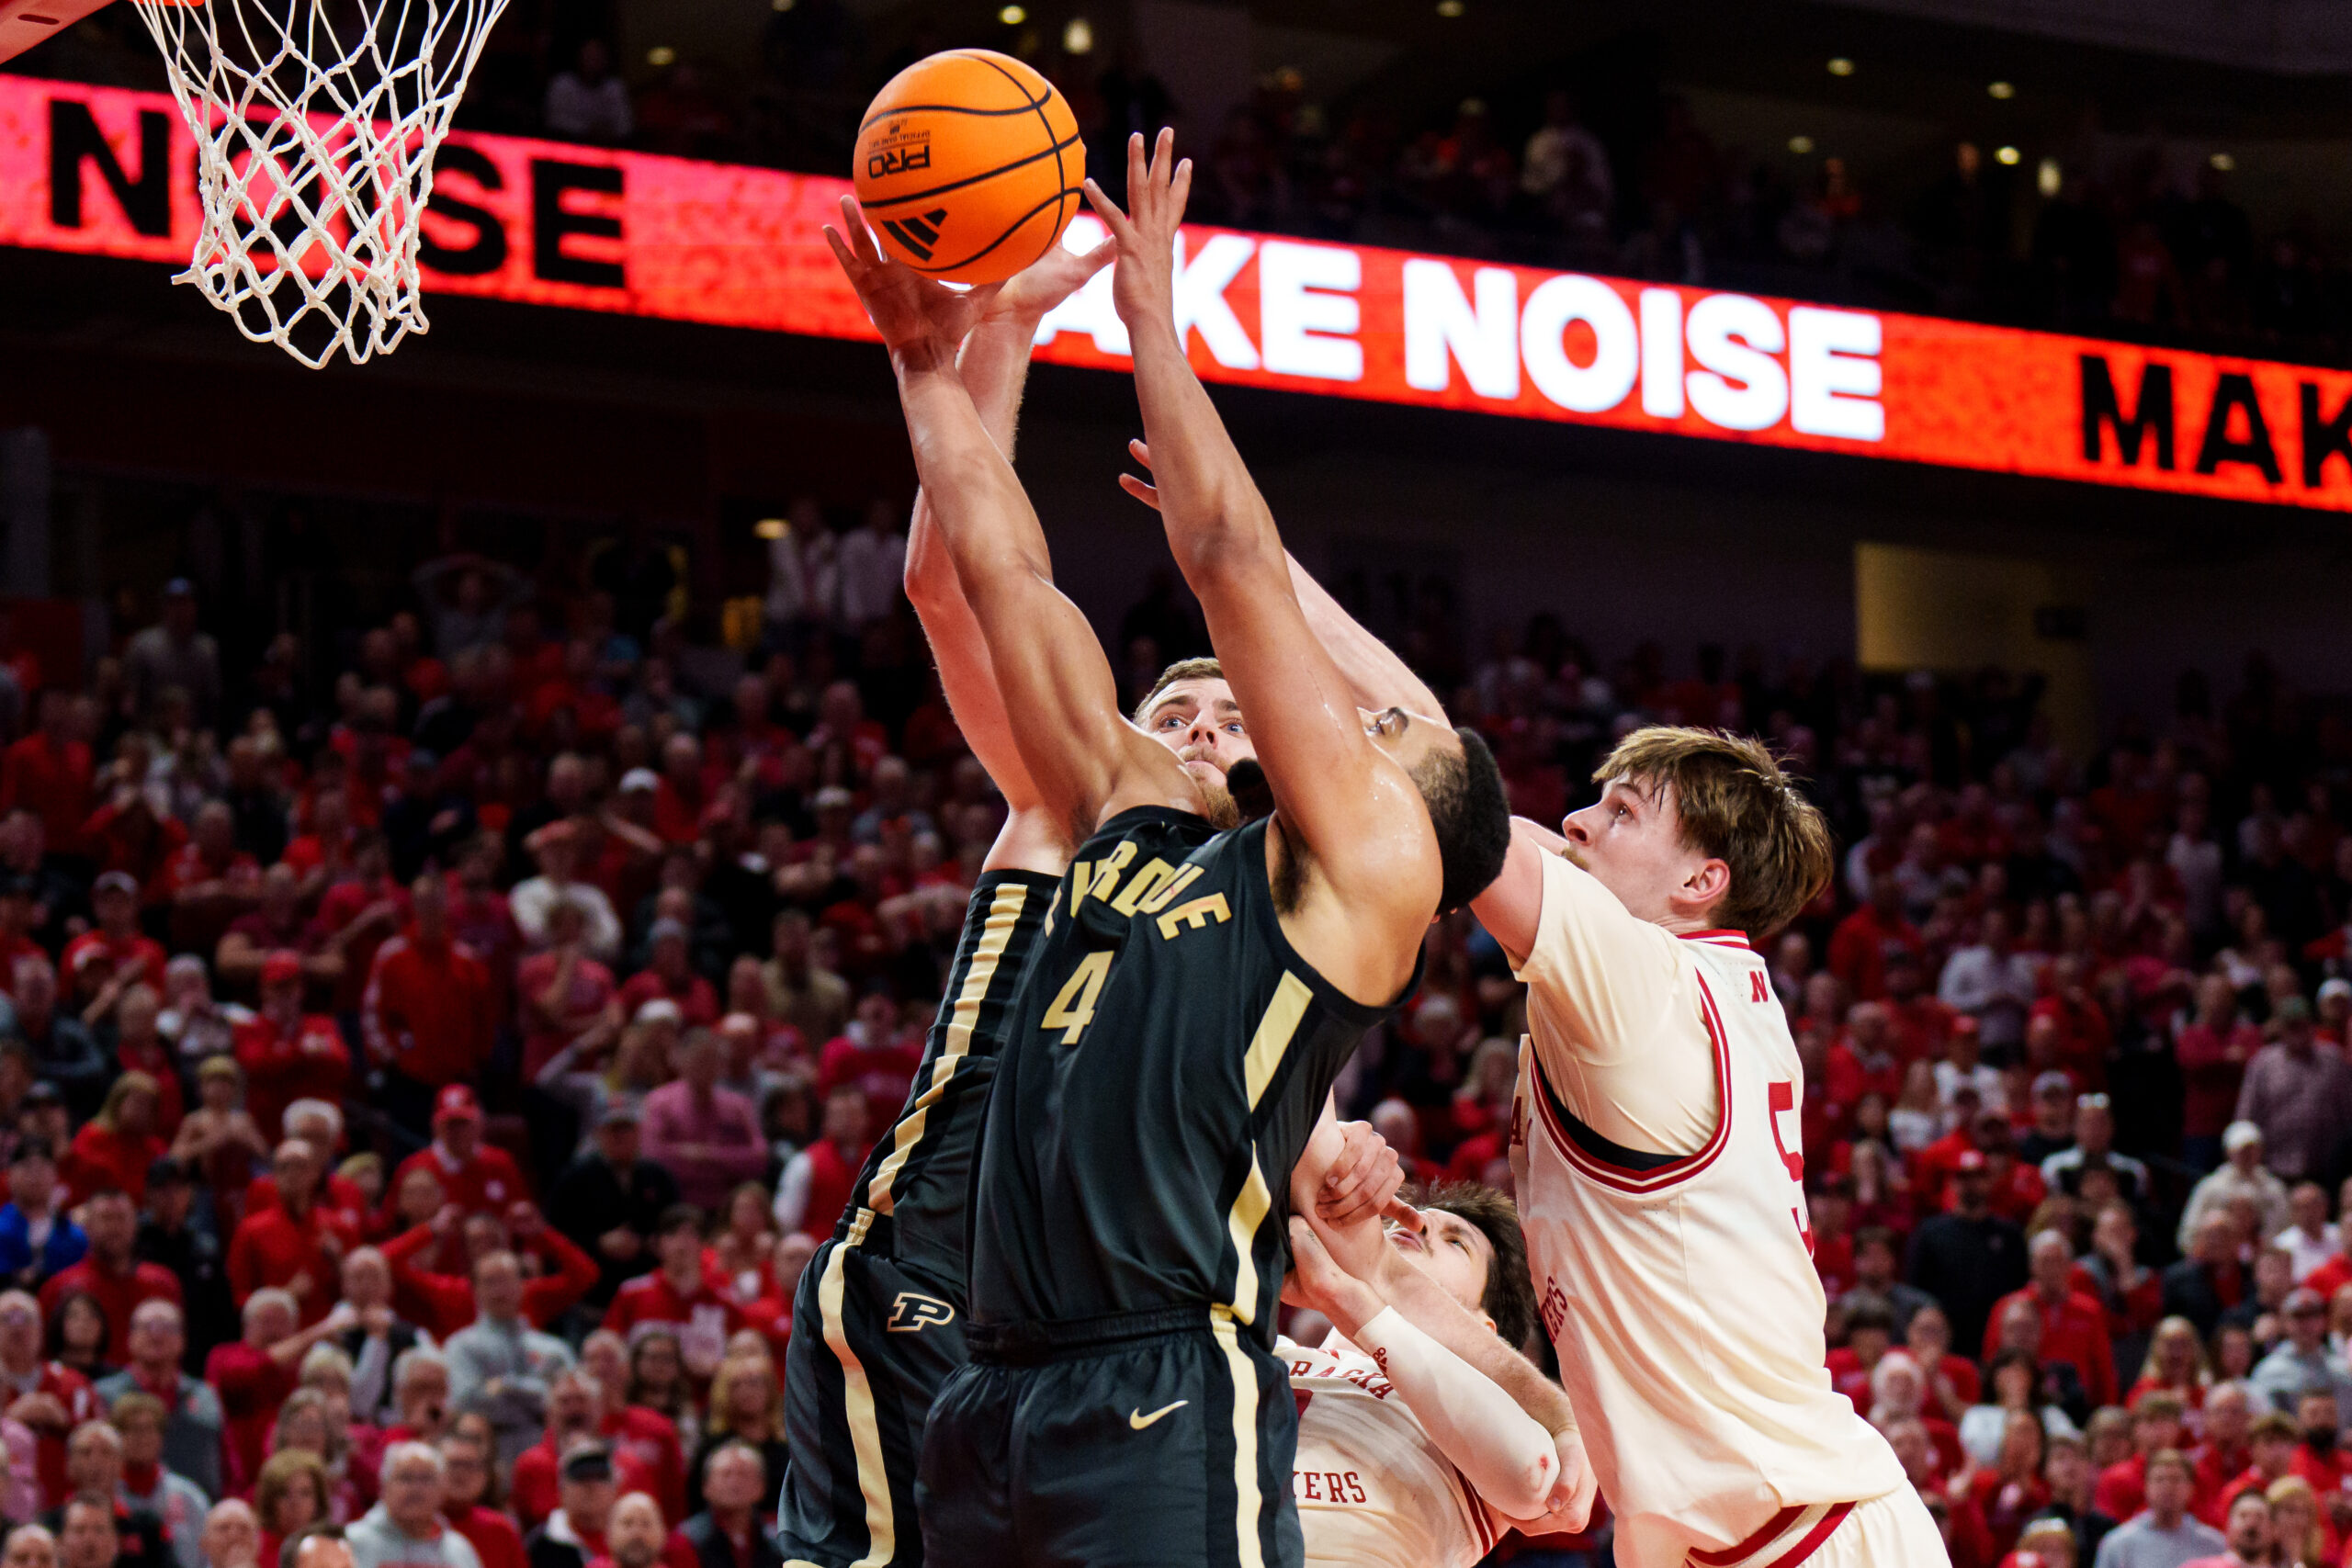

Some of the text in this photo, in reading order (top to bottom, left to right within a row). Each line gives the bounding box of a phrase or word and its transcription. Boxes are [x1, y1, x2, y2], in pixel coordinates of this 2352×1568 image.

[51, 99, 625, 288] NOISE
[868, 145, 931, 179] PRO
[956, 214, 1884, 442] AKE NOISE
[1040, 950, 1114, 1045] 4
[1749, 971, 1769, 1003] N
[887, 1292, 955, 1332] P
